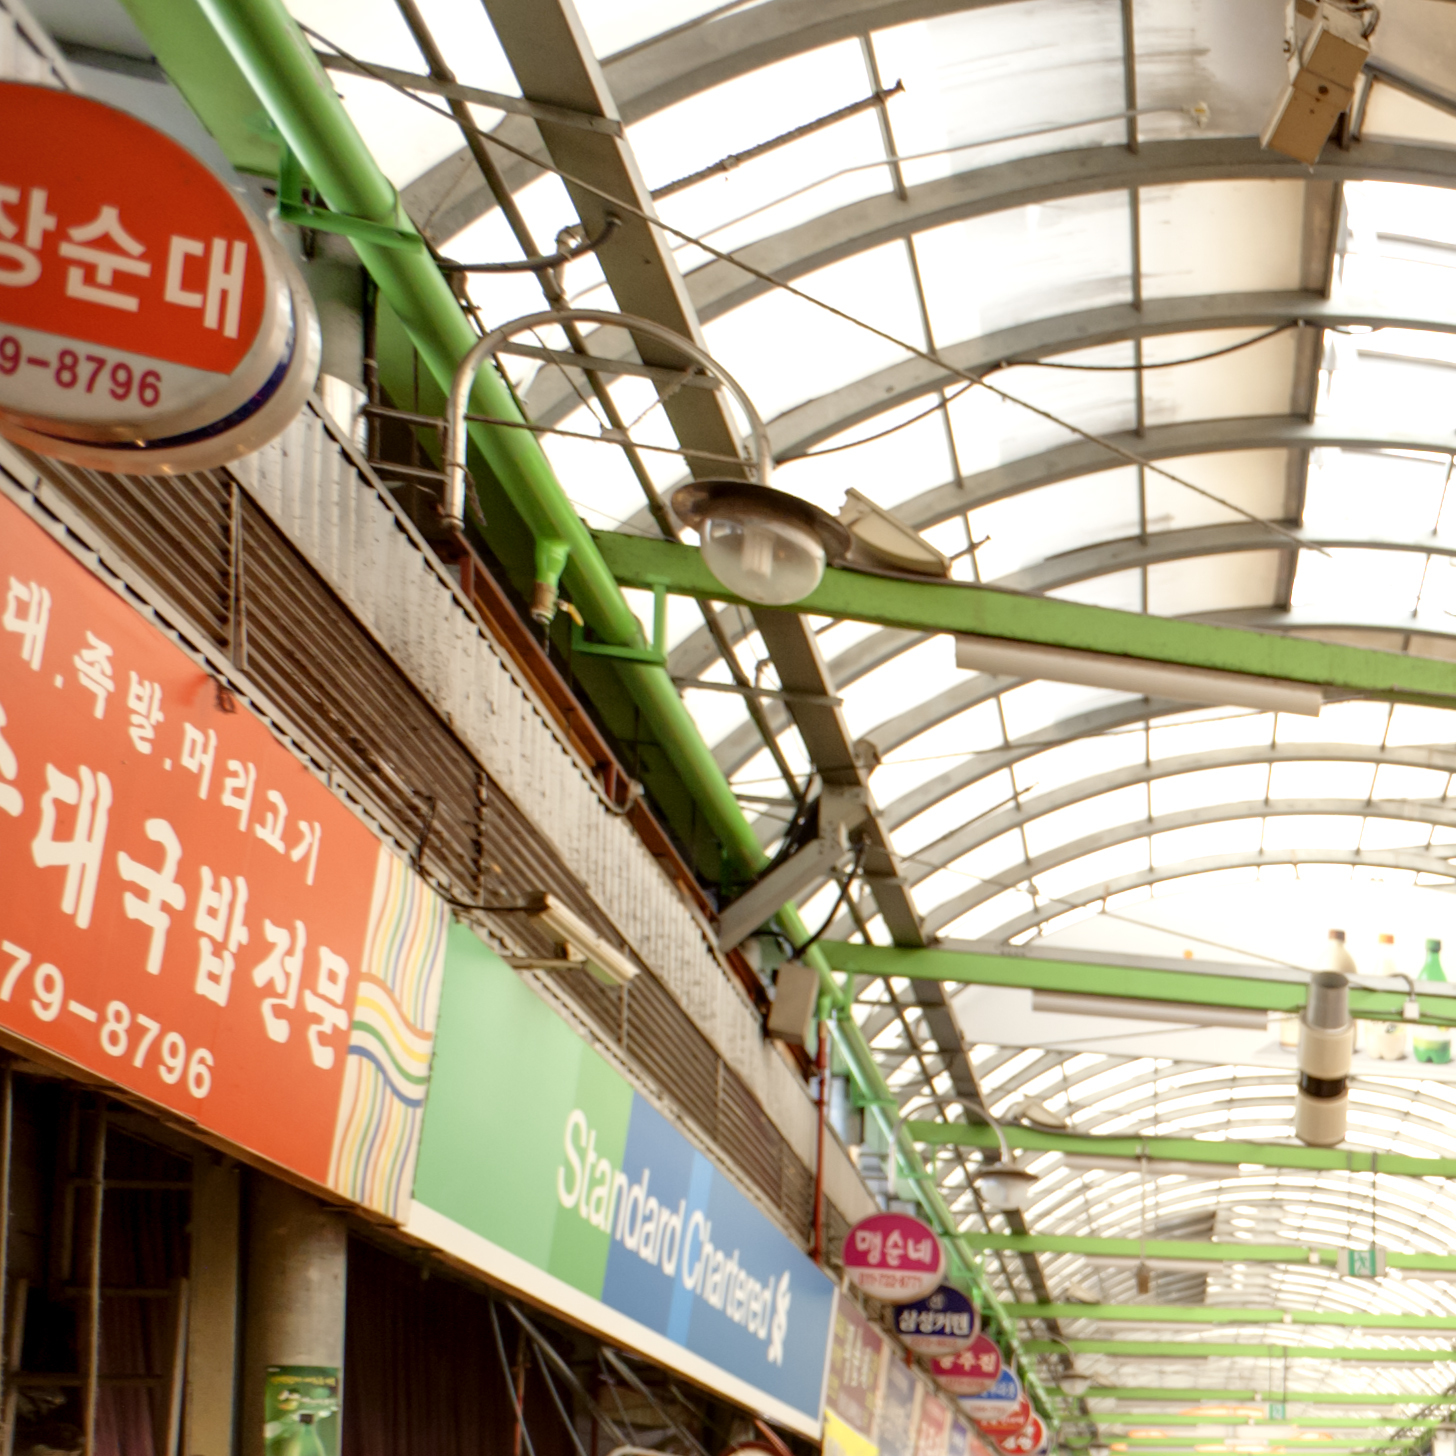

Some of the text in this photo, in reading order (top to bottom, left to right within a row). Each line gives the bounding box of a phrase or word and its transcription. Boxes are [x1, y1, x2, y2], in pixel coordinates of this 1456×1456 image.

[0, 708, 350, 1070] 대국밥전문
[557, 1108, 776, 1341] Standard Chartered
